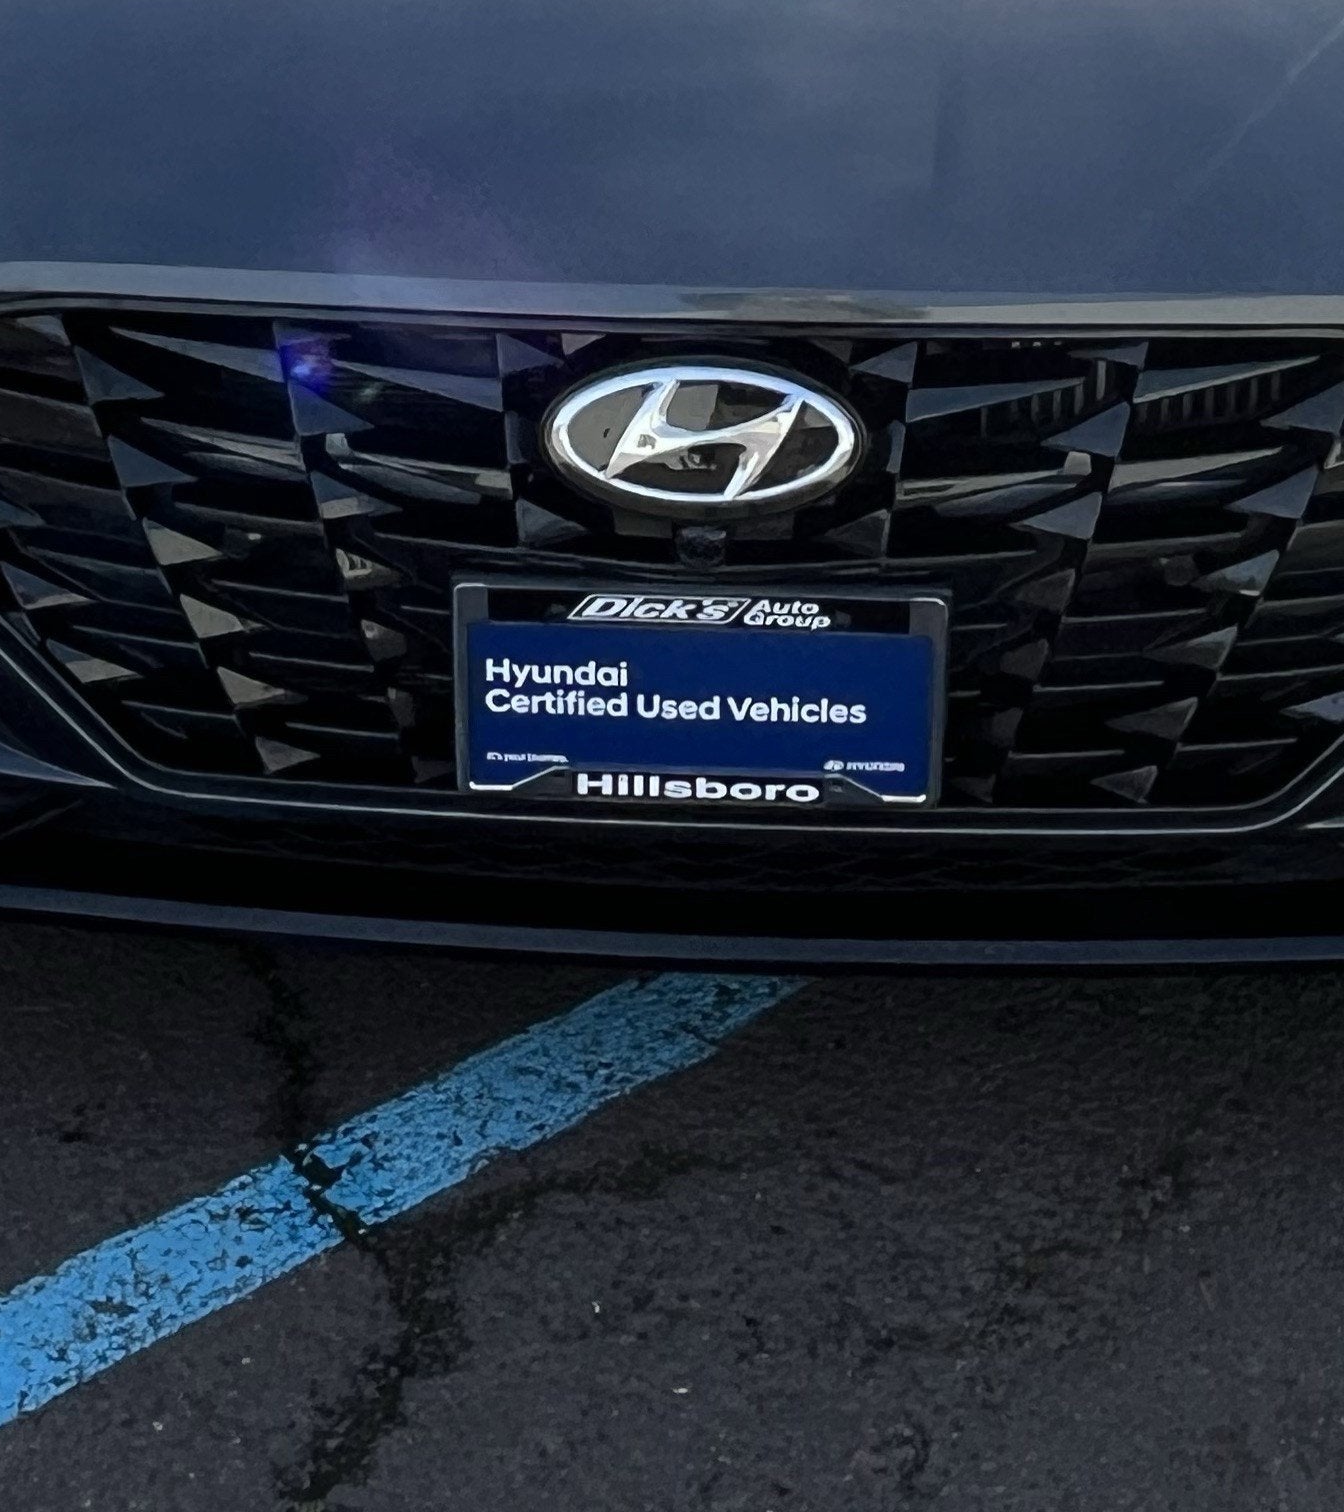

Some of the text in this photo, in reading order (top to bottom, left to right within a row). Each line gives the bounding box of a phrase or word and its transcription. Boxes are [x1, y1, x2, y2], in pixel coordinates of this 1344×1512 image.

[742, 611, 831, 631] Group
[753, 599, 820, 615] Auto
[484, 658, 628, 687] Hyundai
[484, 688, 868, 725] Certified Used Vehicles
[576, 772, 821, 803] Hillsboro
